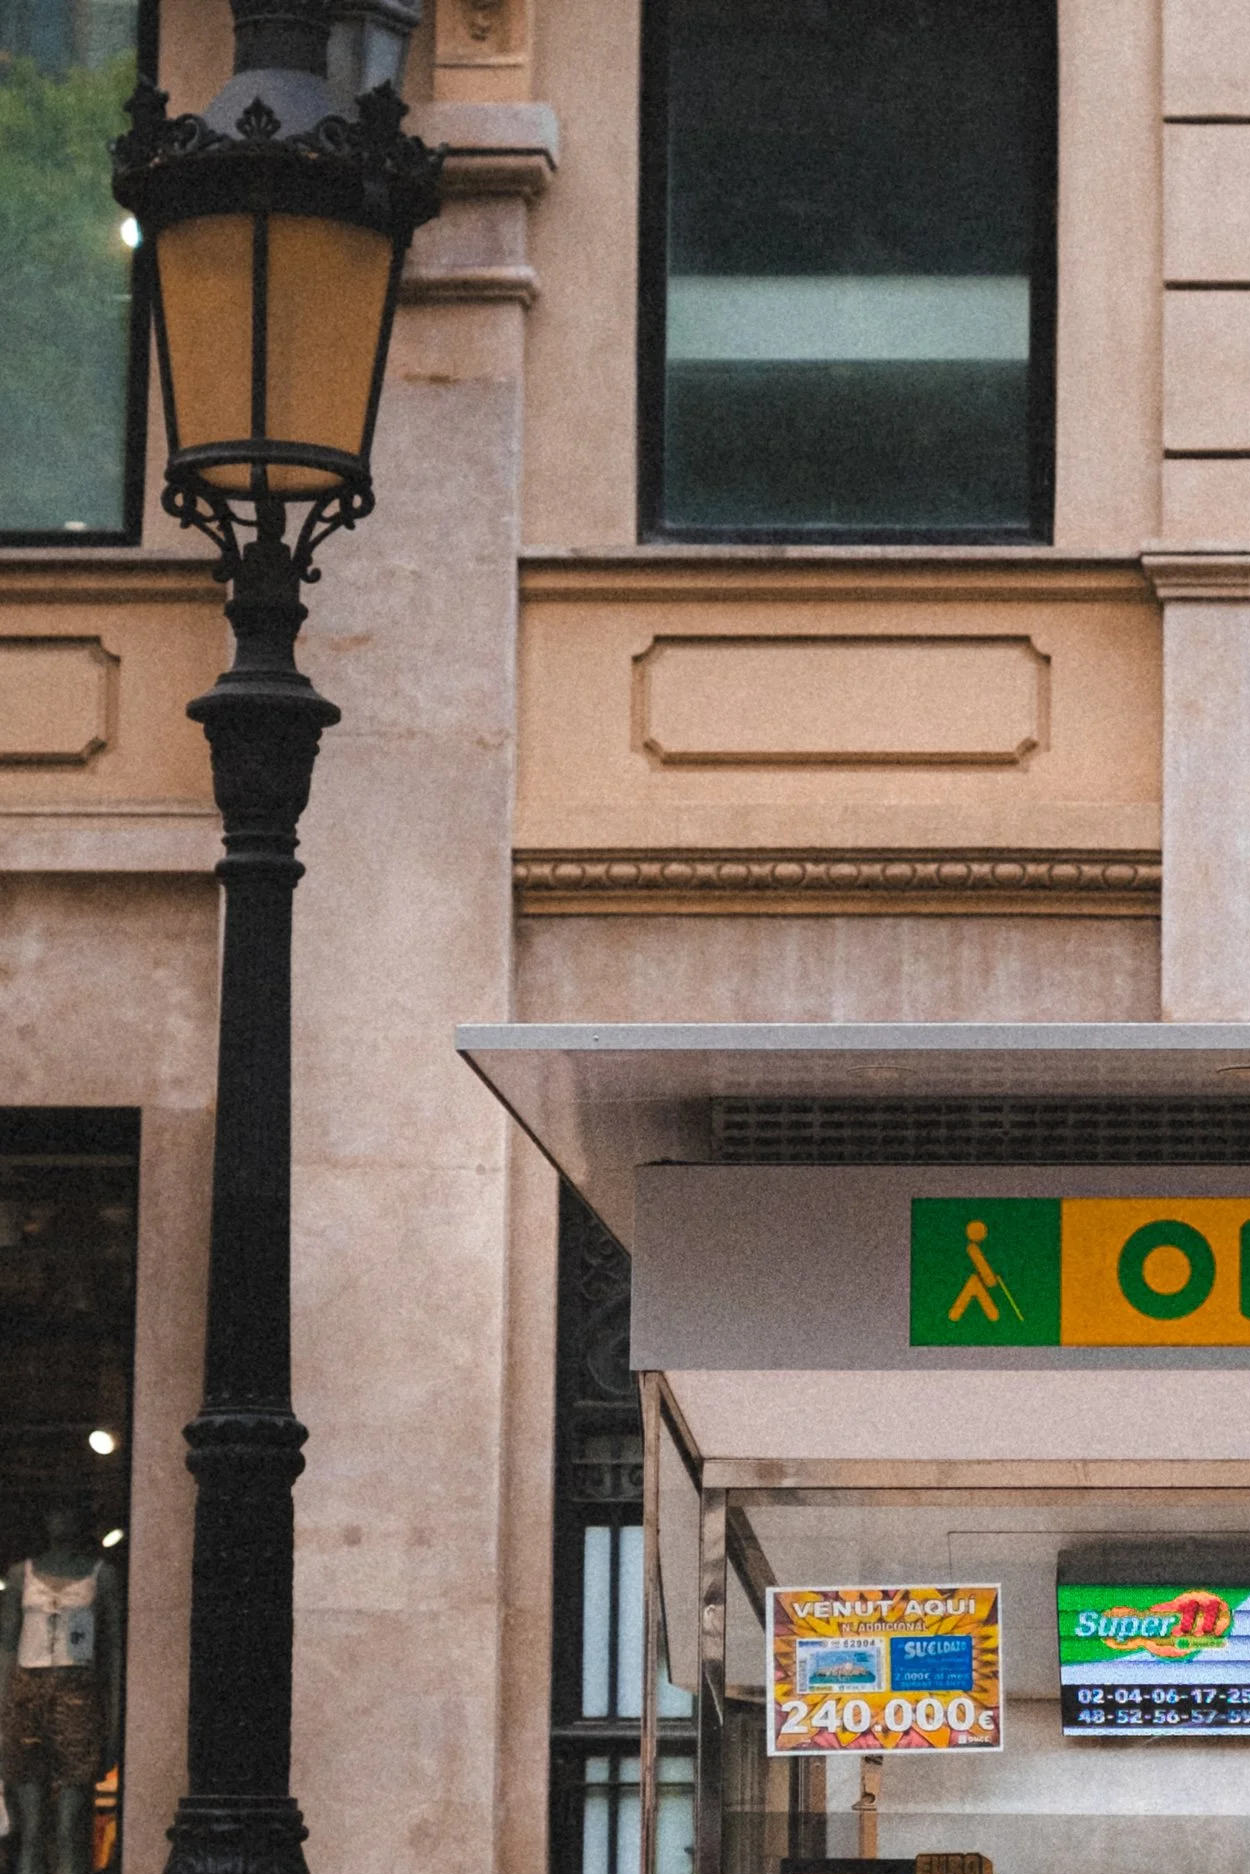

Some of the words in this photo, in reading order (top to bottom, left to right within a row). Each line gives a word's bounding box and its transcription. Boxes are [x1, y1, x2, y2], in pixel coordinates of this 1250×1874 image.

[792, 1599, 894, 1619] VENUT
[904, 1594, 976, 1615] AQUÍ
[1075, 1610, 1176, 1642] Super
[1176, 1599, 1221, 1634] 11
[858, 1622, 929, 1632] ADDICIONAL
[780, 1697, 995, 1735] 240.000€
